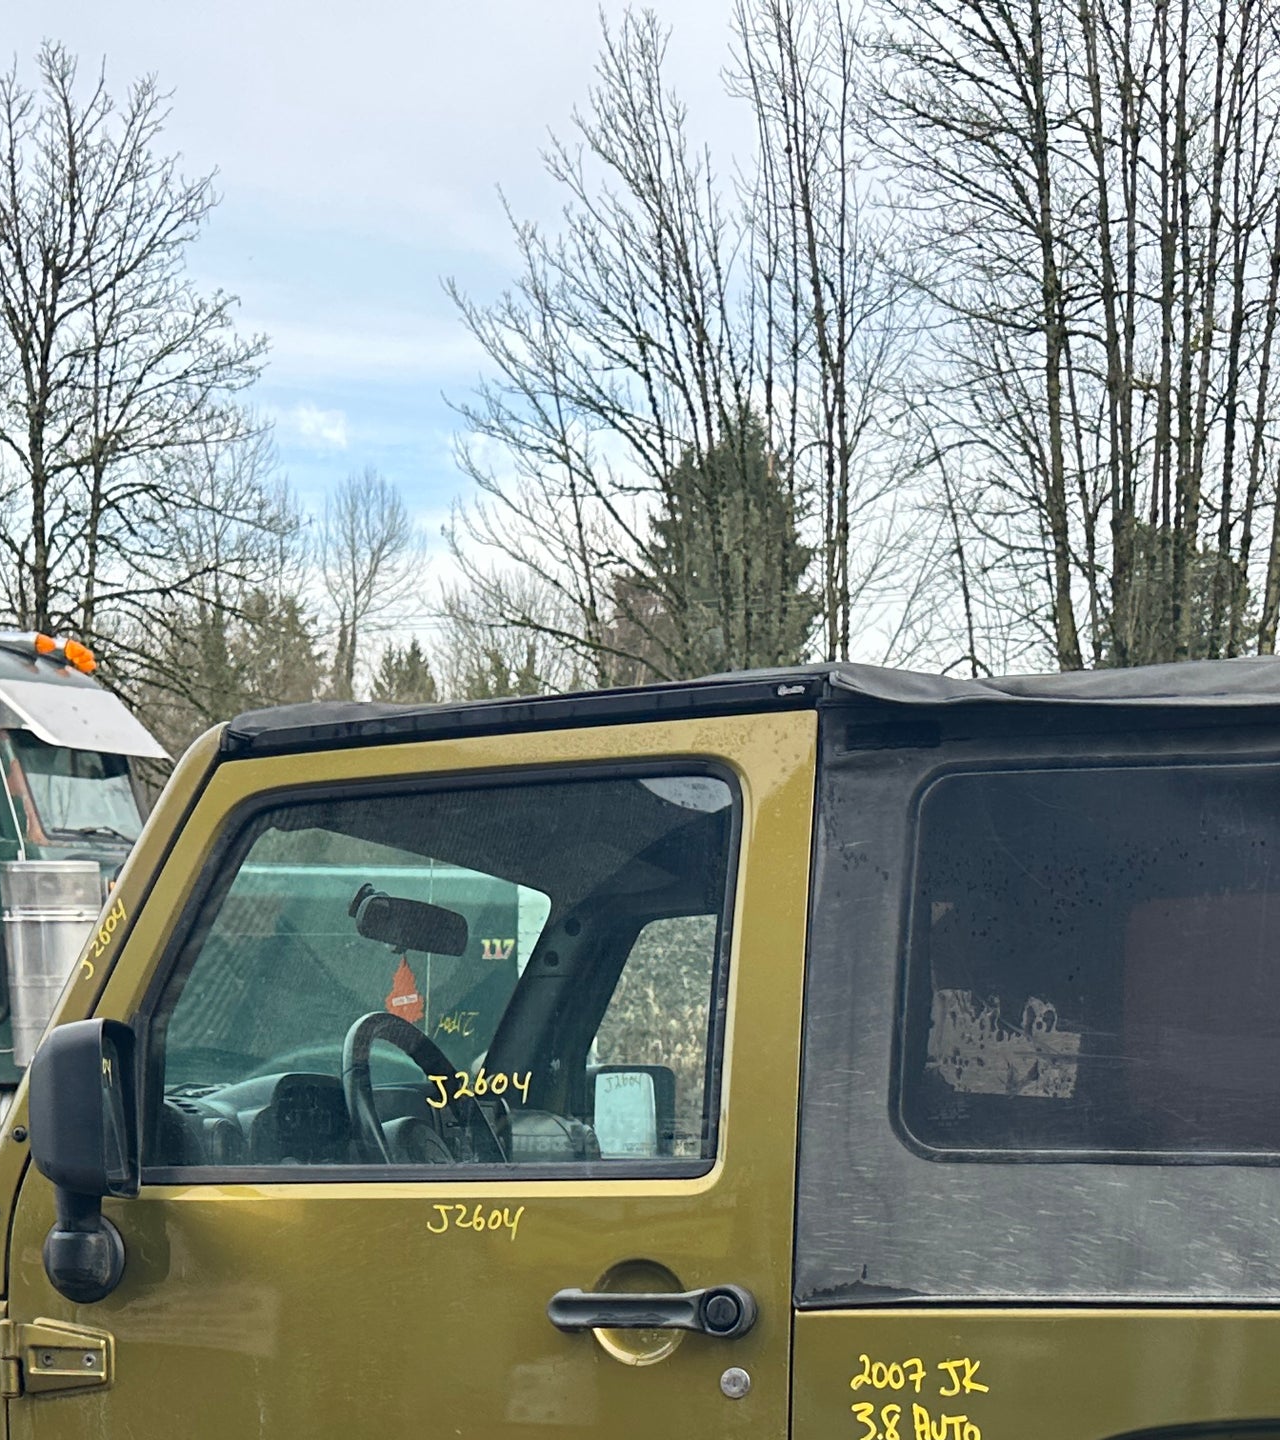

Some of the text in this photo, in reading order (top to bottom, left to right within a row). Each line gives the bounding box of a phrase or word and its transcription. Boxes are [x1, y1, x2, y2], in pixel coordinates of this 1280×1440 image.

[80, 898, 127, 980] J2604
[481, 938, 515, 960] 117
[426, 1068, 532, 1109] J2604
[427, 1204, 525, 1241] J2604
[850, 1354, 990, 1397] 2007 JK
